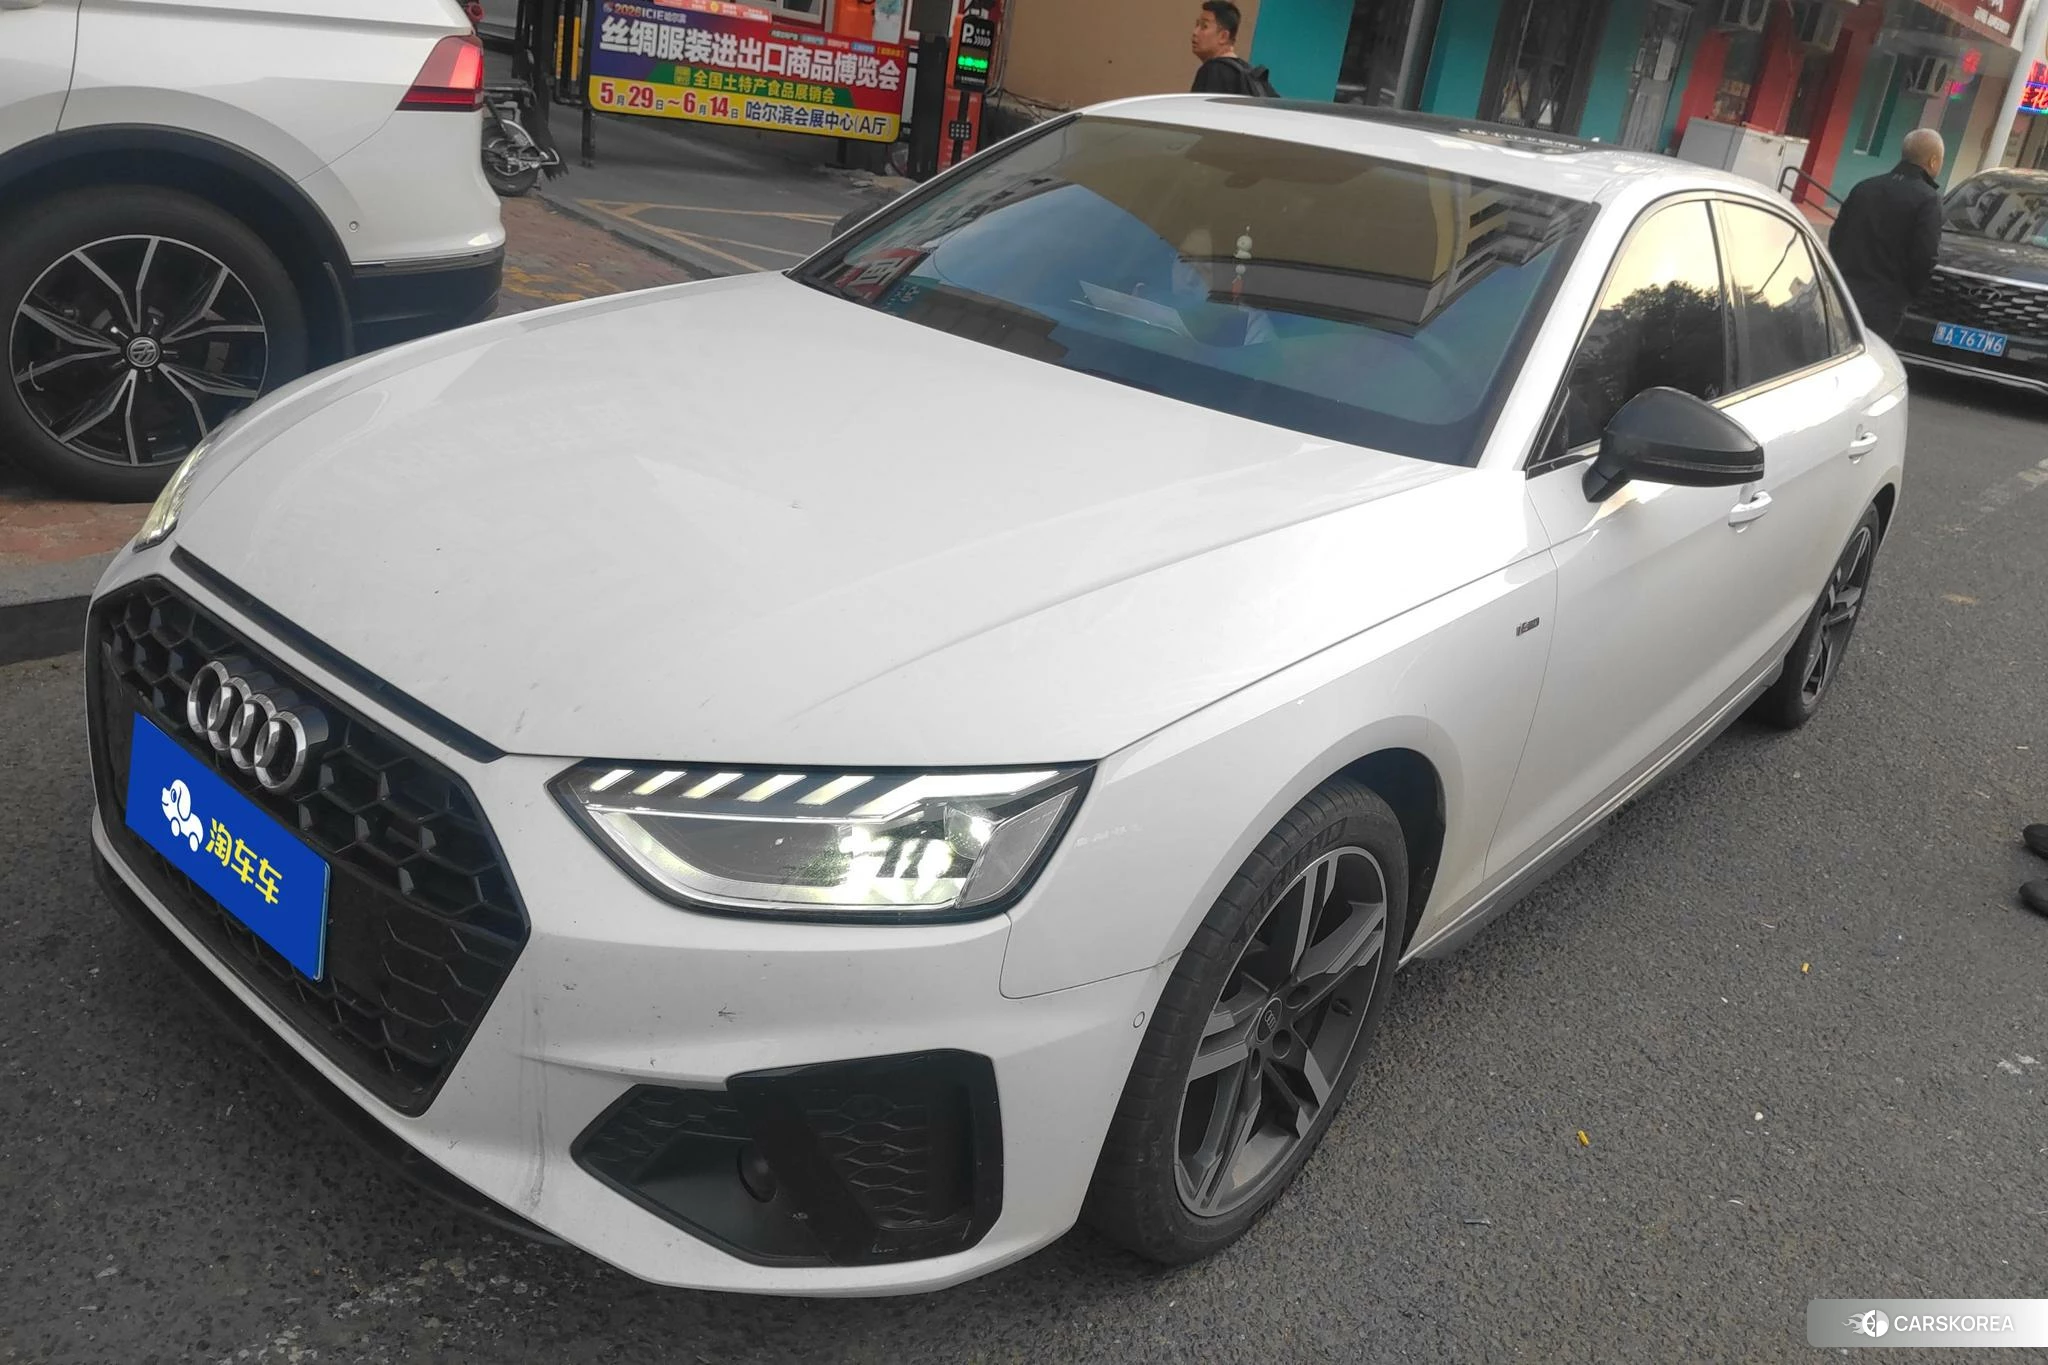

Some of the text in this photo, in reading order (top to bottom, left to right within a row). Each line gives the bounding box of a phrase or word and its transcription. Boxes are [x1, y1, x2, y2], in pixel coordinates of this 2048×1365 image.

[600, 16, 900, 91] 丝绸服装进出口商品博览会
[693, 70, 835, 104] 全国土特产食品展销会
